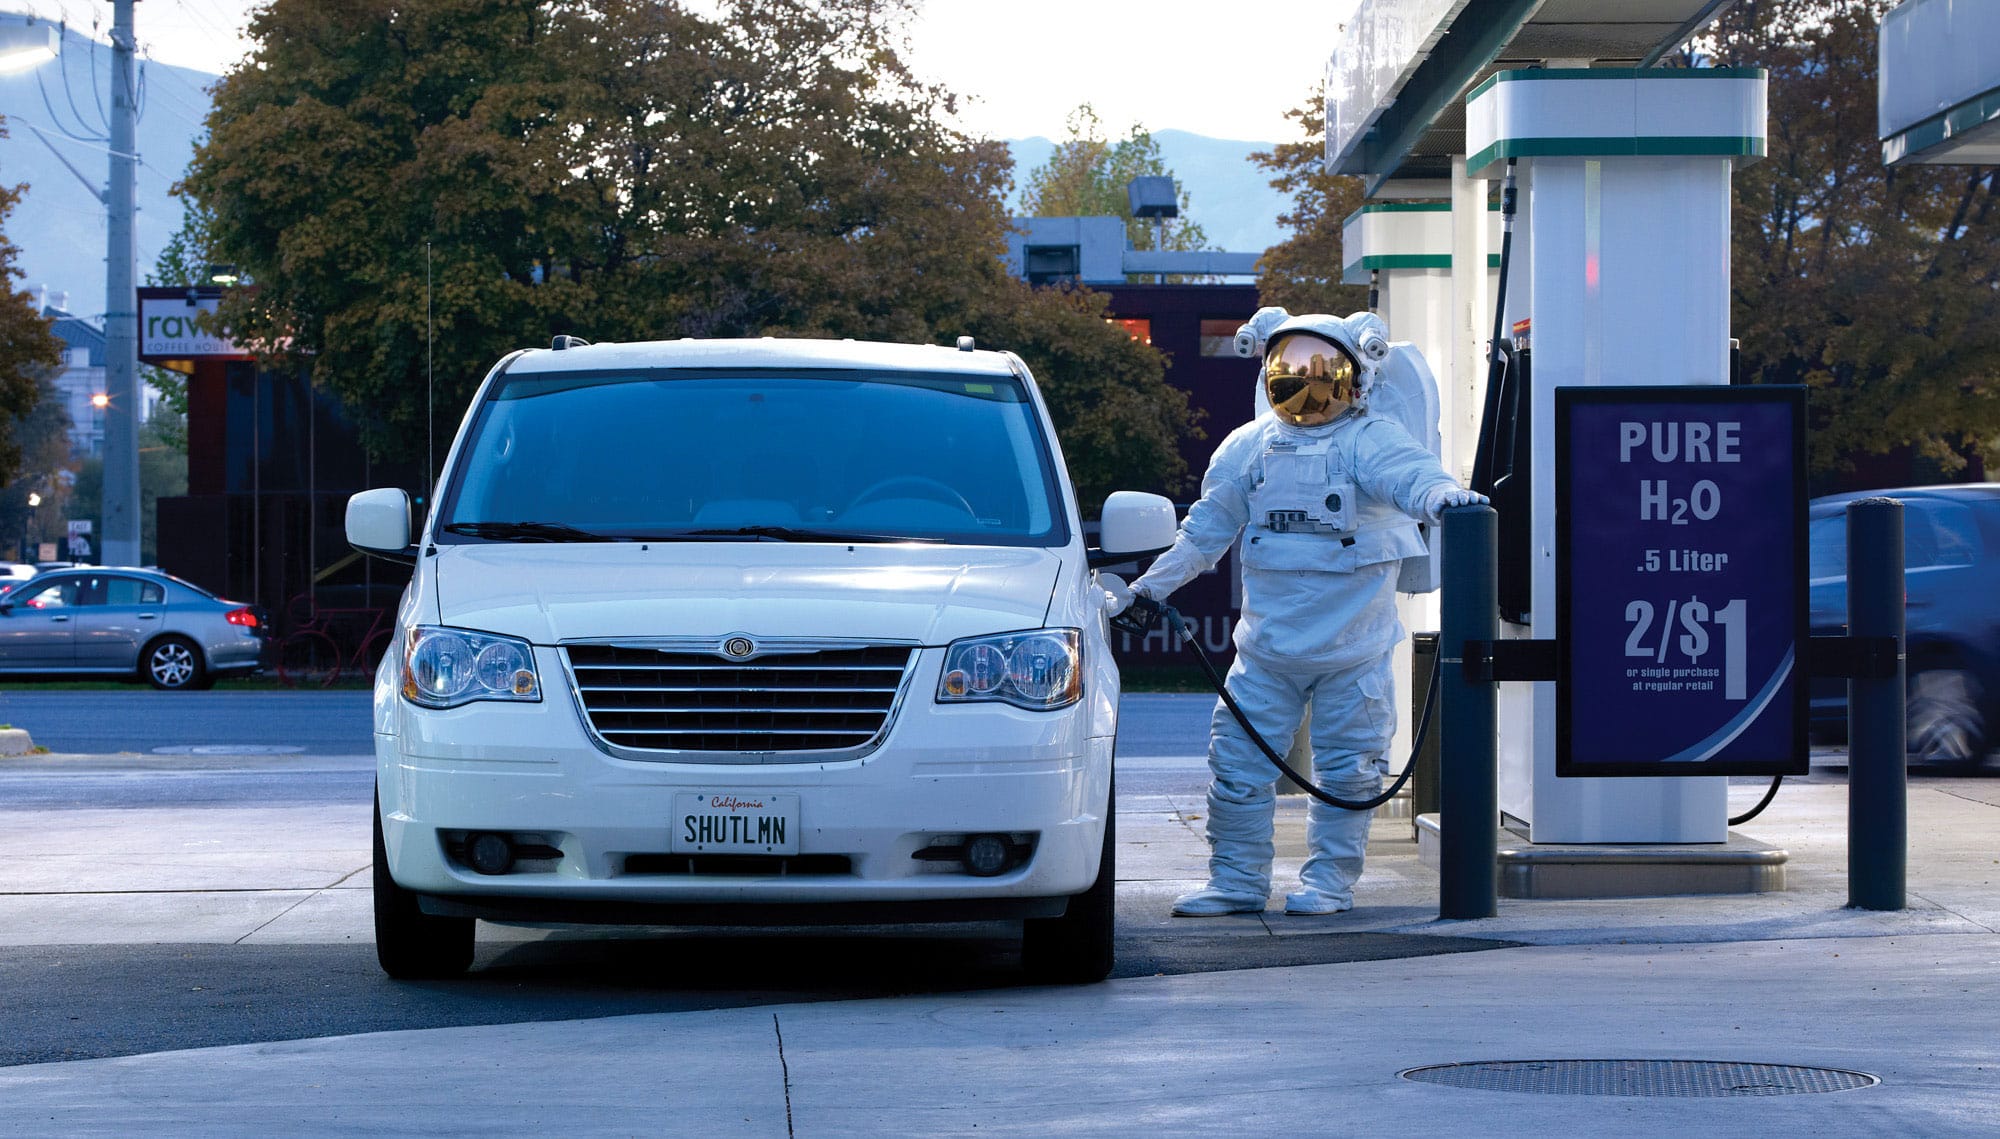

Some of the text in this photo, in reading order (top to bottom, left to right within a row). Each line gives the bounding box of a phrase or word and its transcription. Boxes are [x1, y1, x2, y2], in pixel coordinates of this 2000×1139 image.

[147, 342, 188, 352] COFFEE
[1620, 422, 1741, 463] PURE
[1640, 479, 1721, 525] H2O
[1637, 549, 1728, 572] .5 Liter
[1625, 595, 1747, 699] 2/$1
[1626, 667, 1720, 678] or single purchase
[1633, 680, 1714, 692] at regular retail
[711, 796, 764, 812] California
[684, 815, 786, 844] SHUTLMN
